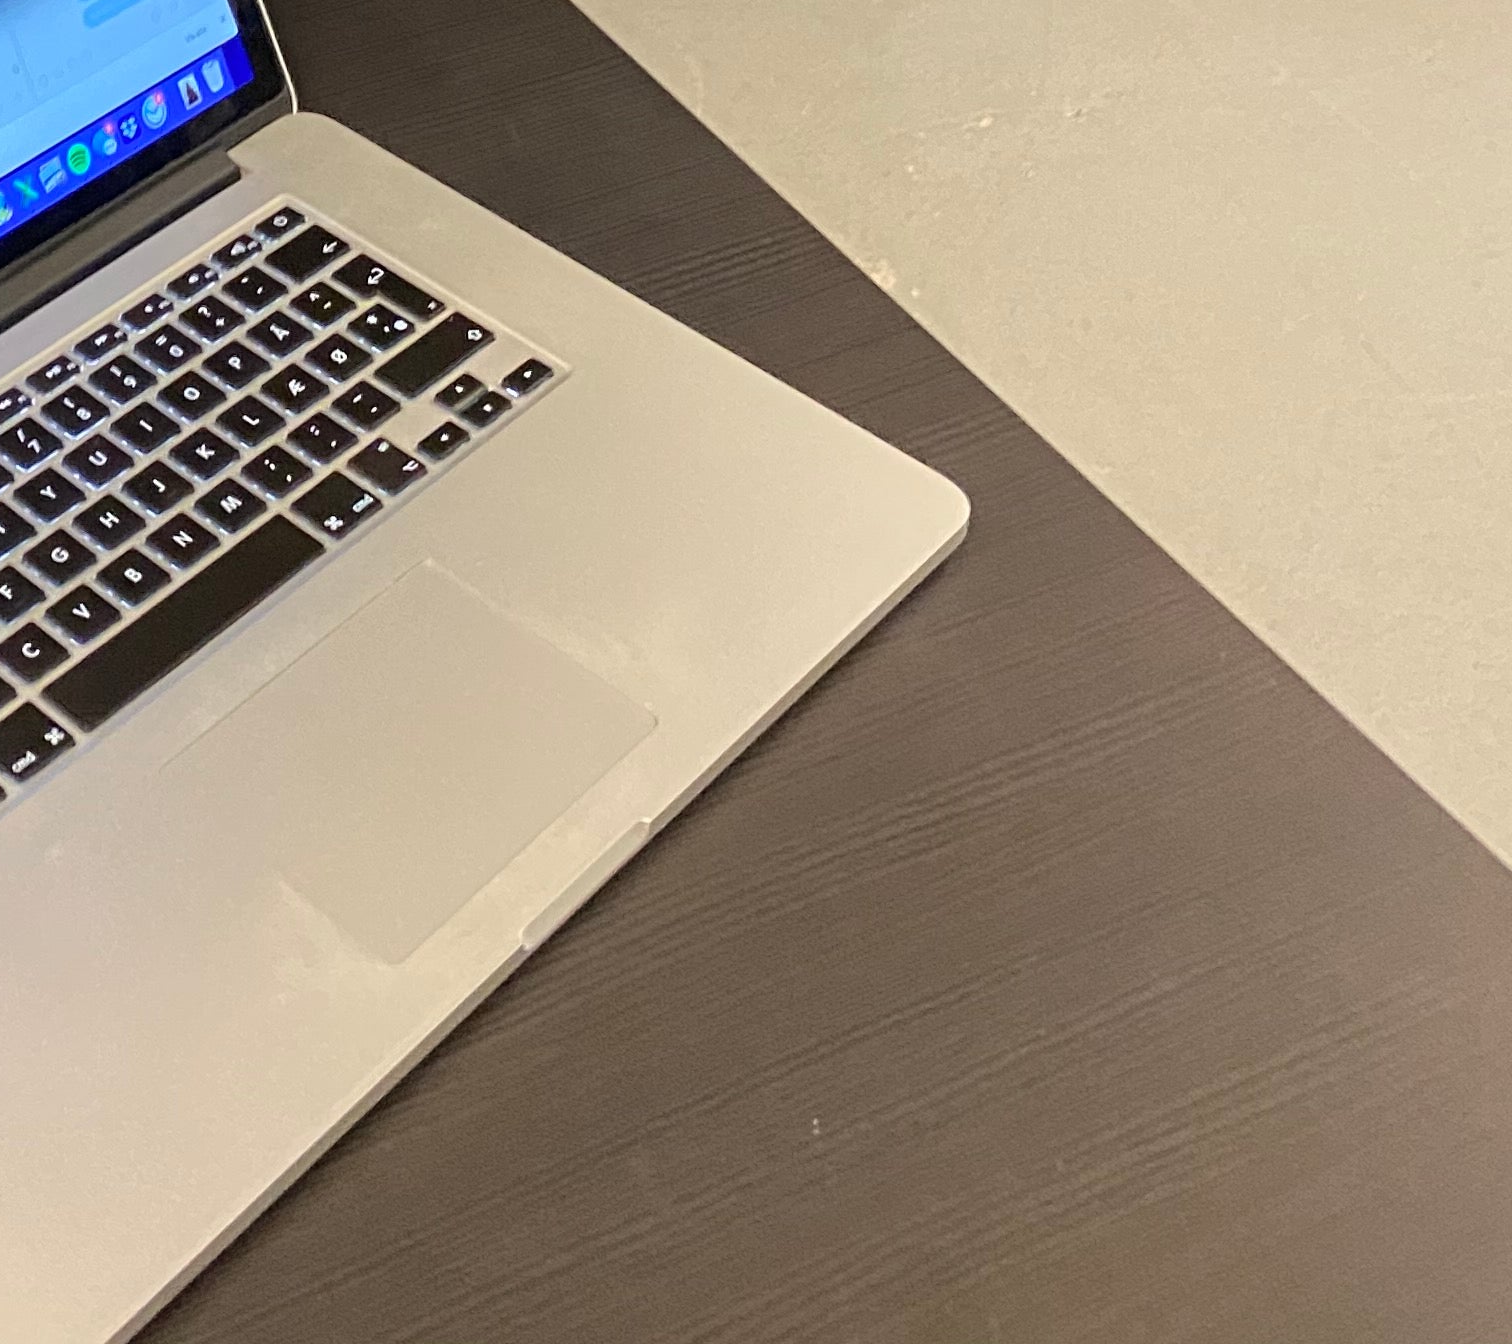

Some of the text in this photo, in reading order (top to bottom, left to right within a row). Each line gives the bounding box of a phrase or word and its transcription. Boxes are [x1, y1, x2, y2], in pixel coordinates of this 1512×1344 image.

[269, 323, 290, 342] Å
[169, 343, 184, 358] 0
[228, 356, 241, 370] P
[123, 375, 137, 389] 9
[183, 387, 201, 401] O
[242, 414, 260, 426] L
[27, 438, 41, 454] 7
[195, 443, 215, 461] K
[88, 450, 108, 467] U
[39, 486, 57, 500] Y
[152, 478, 166, 493] J
[220, 495, 243, 513] M
[99, 511, 120, 530] H
[172, 529, 194, 548] N
[50, 546, 70, 563] G
[124, 567, 143, 583] B
[71, 603, 91, 619] V
[21, 642, 41, 659] C
